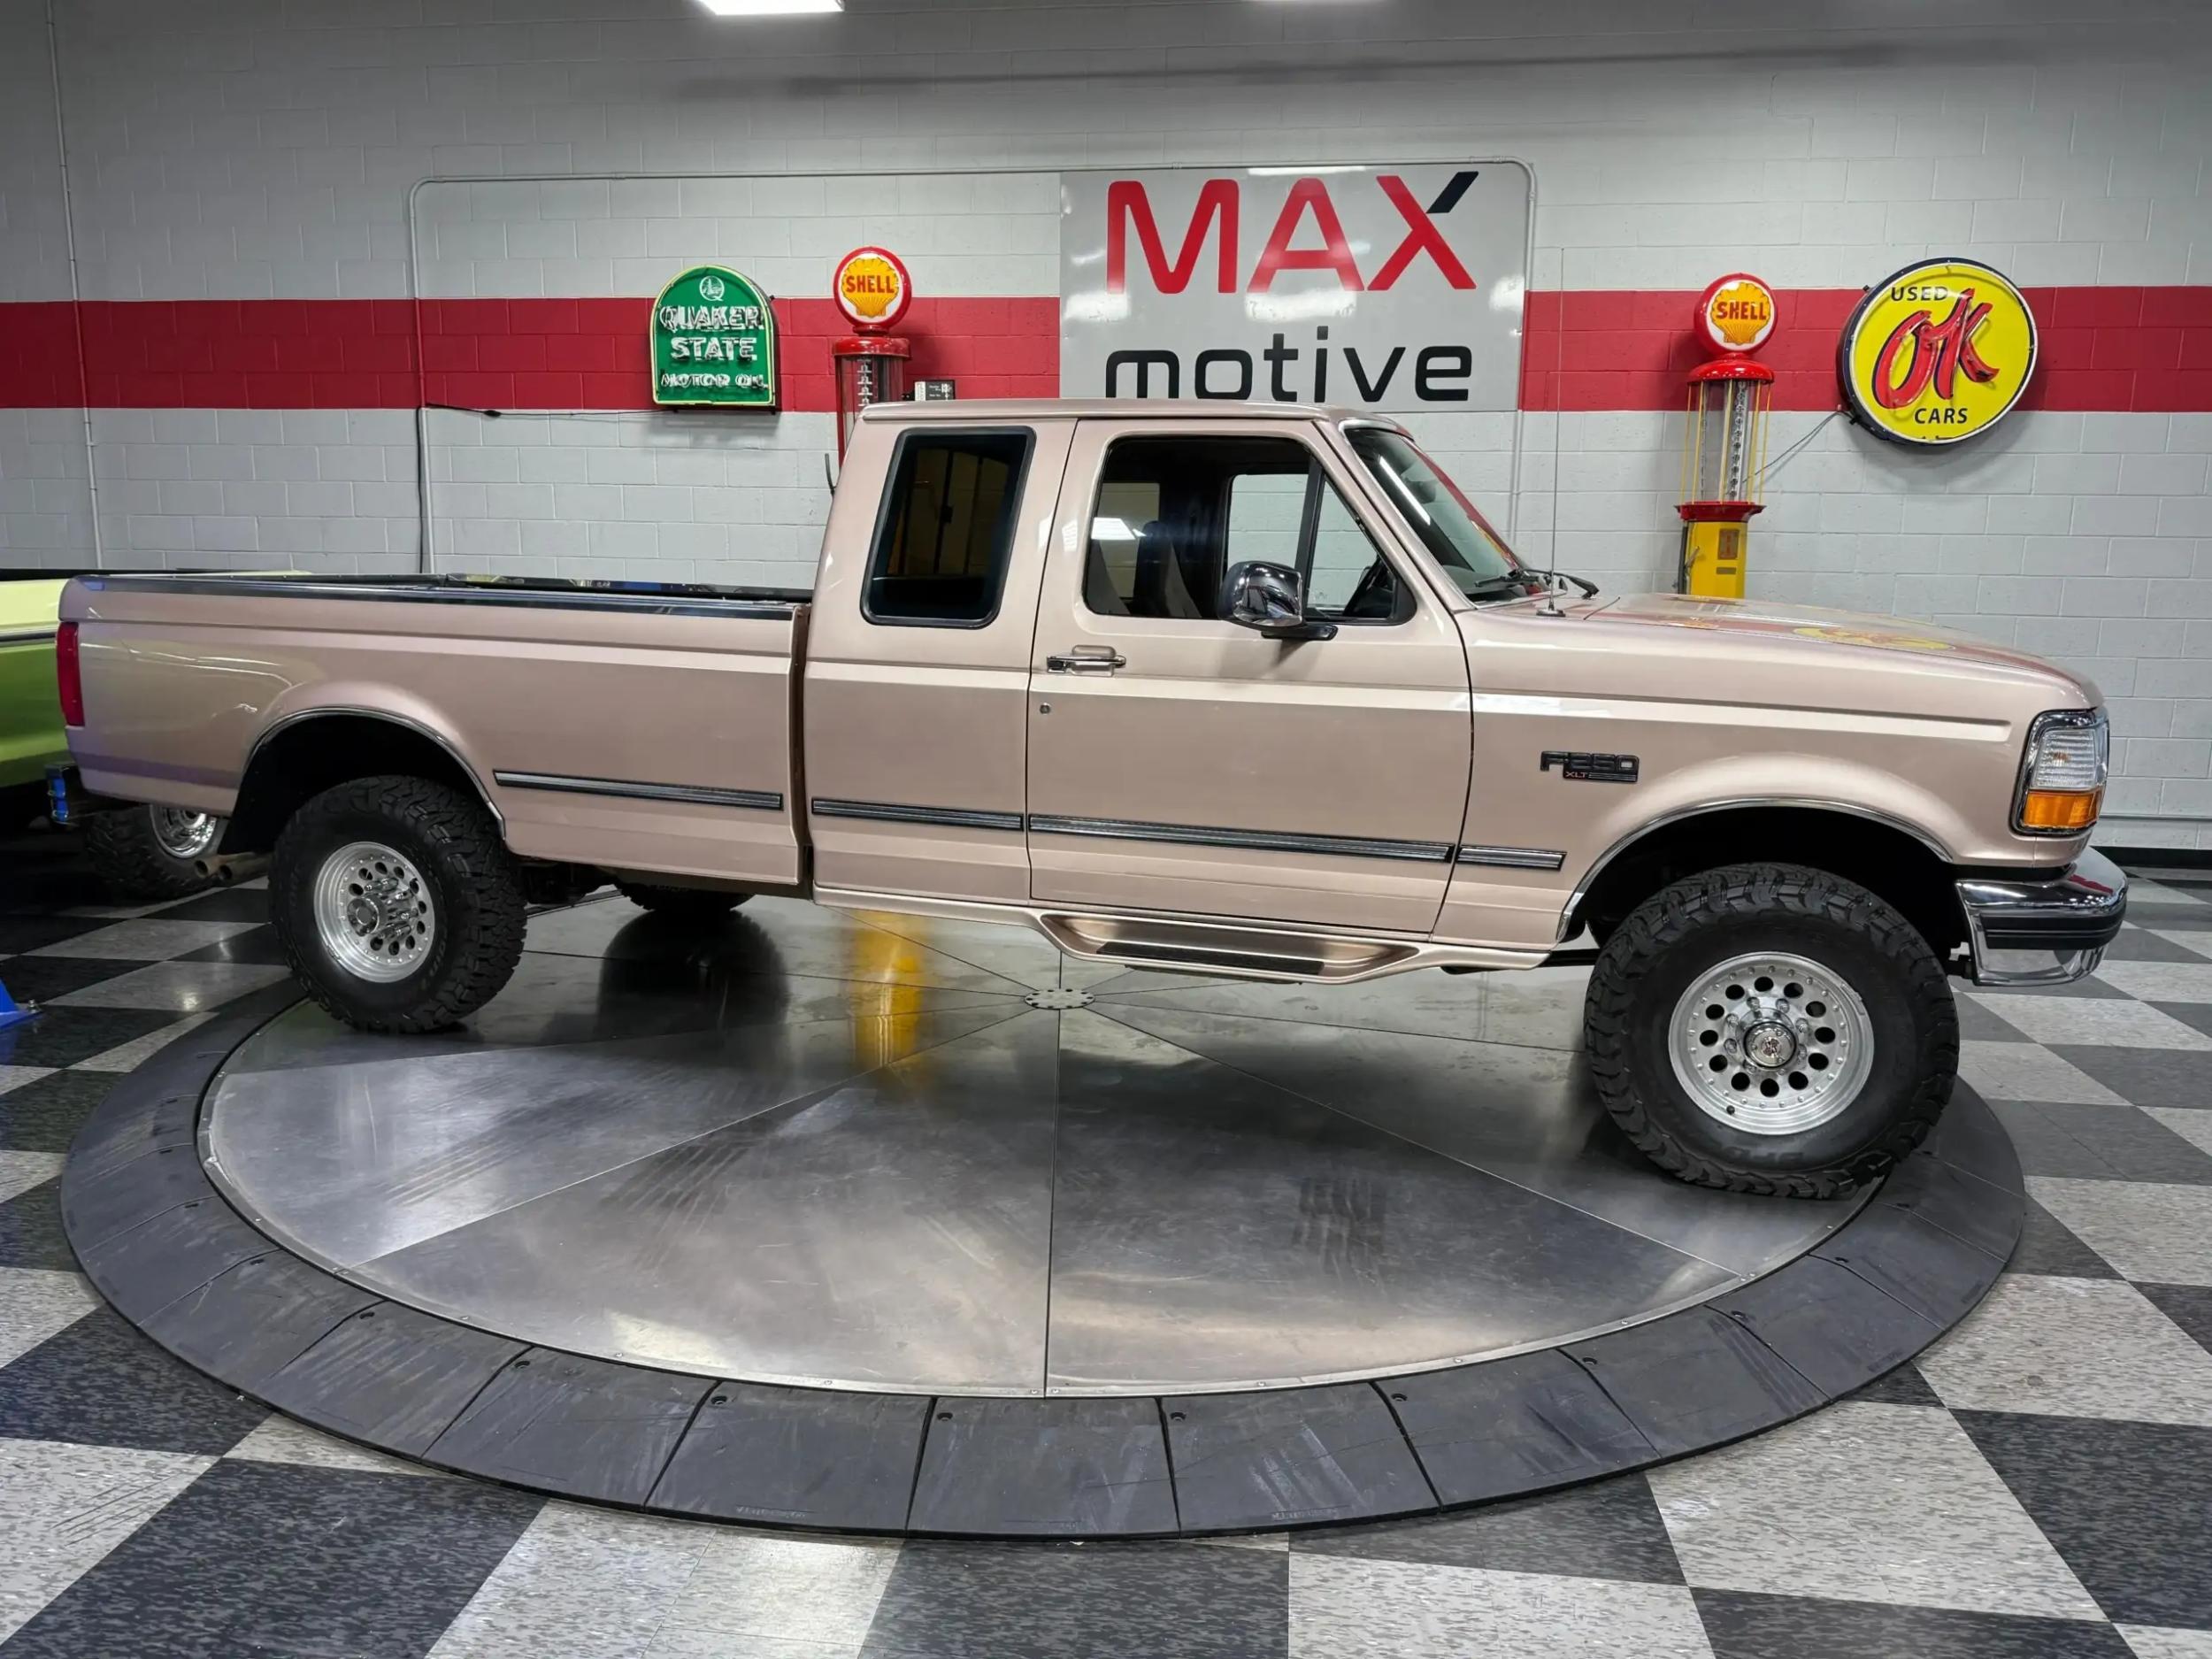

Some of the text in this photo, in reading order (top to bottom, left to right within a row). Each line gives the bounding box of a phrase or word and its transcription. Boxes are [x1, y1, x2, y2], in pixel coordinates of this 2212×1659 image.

[1106, 171, 1479, 295] MAX
[845, 274, 895, 295] SHELL
[1891, 286, 1948, 302] USED
[659, 304, 765, 333] QUAKER
[1717, 300, 1767, 321] SHELL
[671, 336, 757, 361] STATE
[1871, 288, 2000, 409] OK
[1105, 326, 1473, 403] motive
[660, 373, 769, 389] MOTOR OIL
[1914, 407, 1968, 424] CARS
